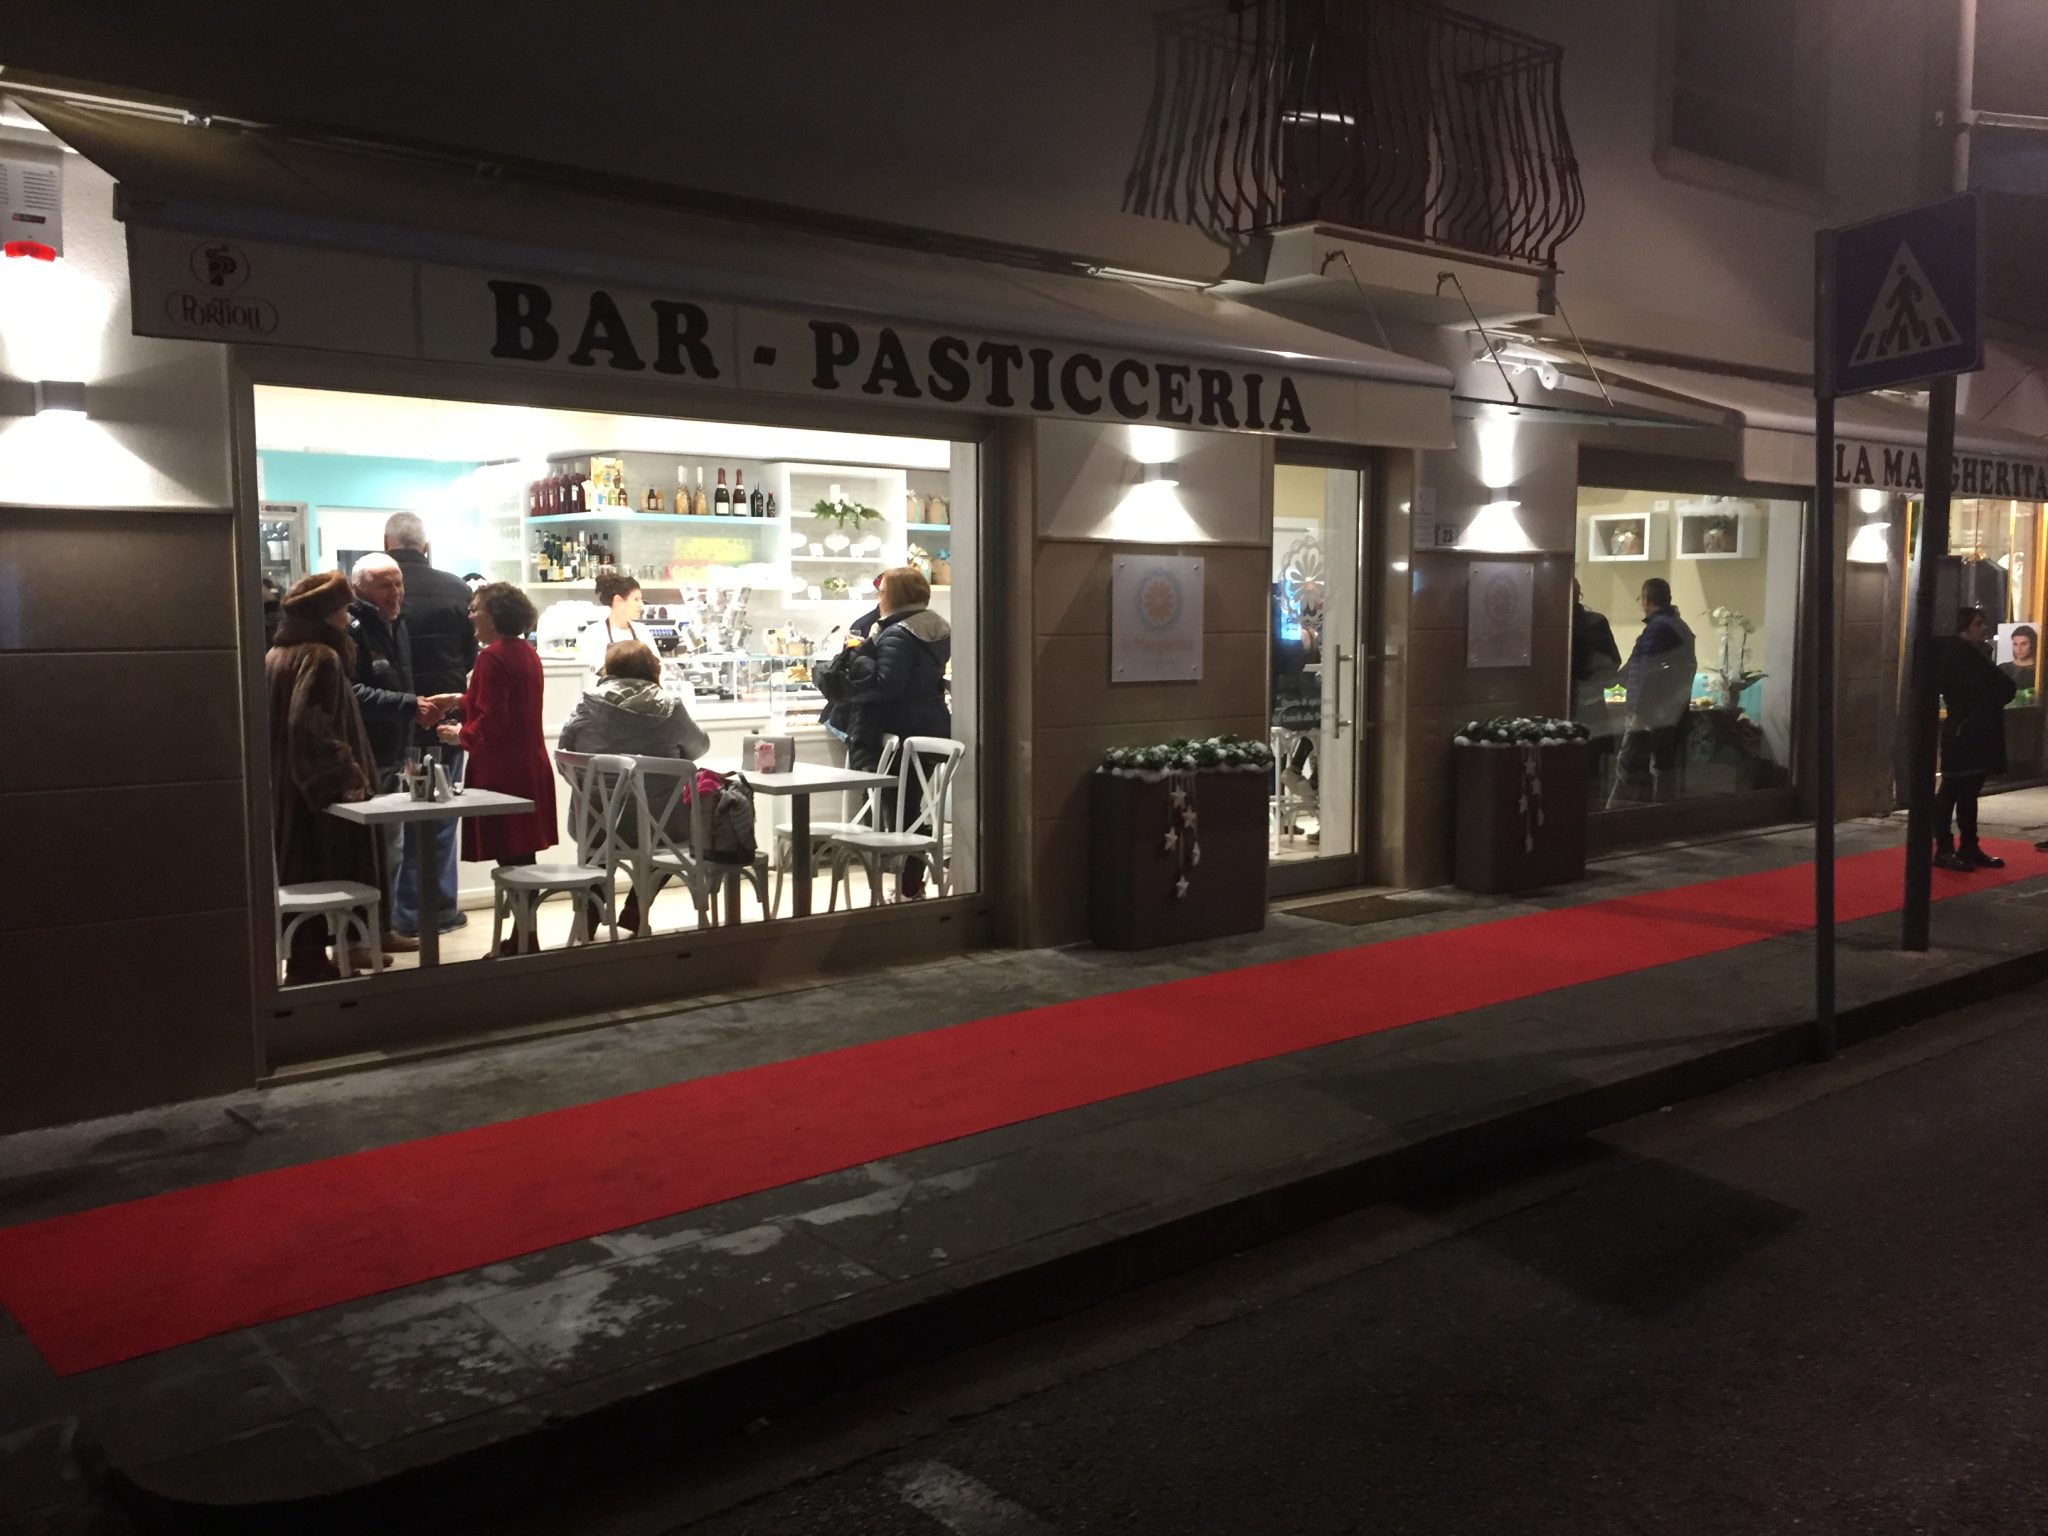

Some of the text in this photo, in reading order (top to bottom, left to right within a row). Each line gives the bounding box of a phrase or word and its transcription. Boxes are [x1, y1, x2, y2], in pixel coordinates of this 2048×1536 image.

[488, 280, 720, 379] BAR
[808, 320, 1311, 433] PASTICCERIA
[1835, 443, 2048, 499] LA MAGHERITA
